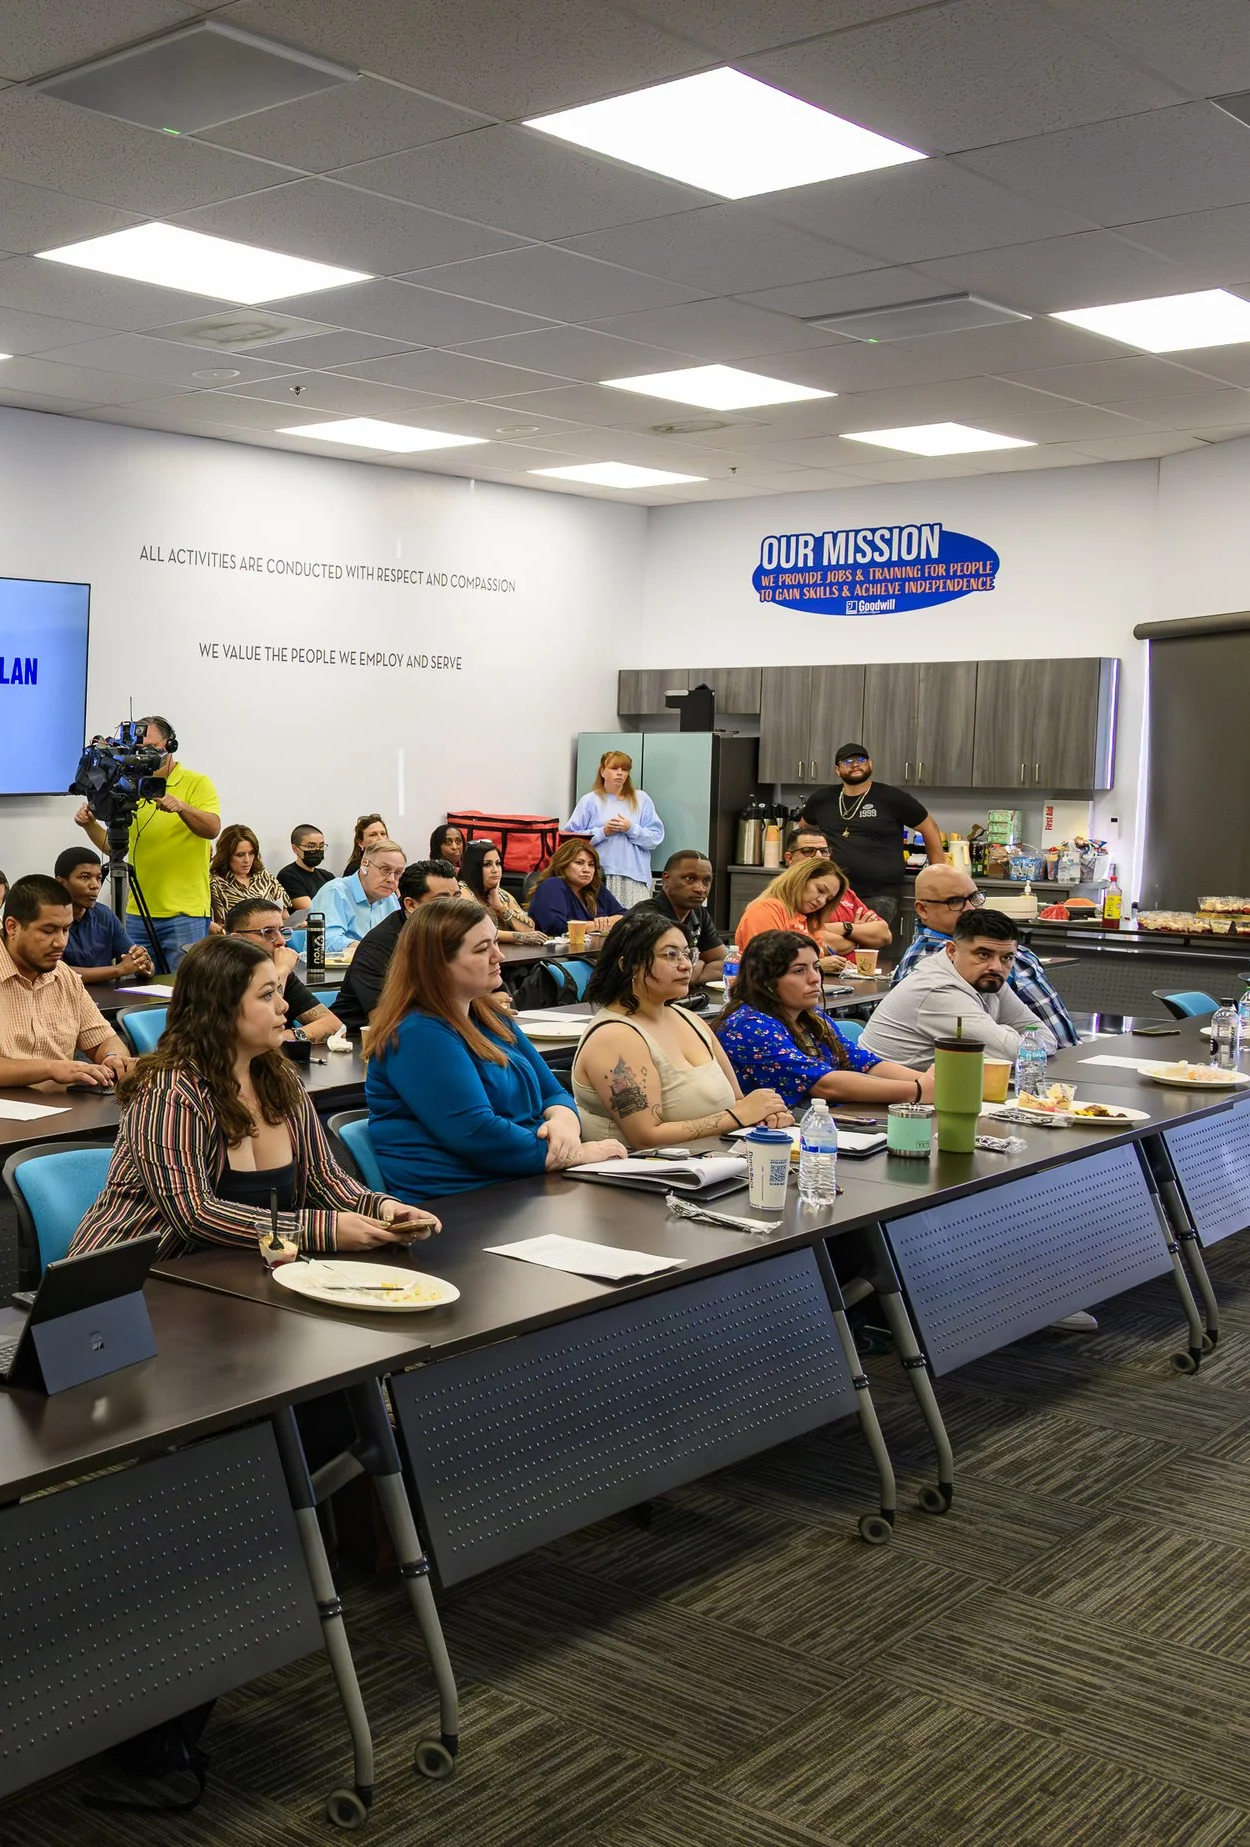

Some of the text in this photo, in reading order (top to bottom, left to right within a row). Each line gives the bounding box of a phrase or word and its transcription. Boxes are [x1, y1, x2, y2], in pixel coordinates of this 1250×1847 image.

[763, 524, 941, 570] OUR MISSION
[140, 545, 516, 593] ALL ACTIVITIES ARE CONDUCTED WITH RESPECT AND COMPASSION
[761, 561, 993, 586] WE PROVIDE JOBS & TRAINING FOR PEOPLE
[759, 576, 995, 601] TO GAIN SKILLS & ACHIEVE INDEPENDENCE
[858, 599, 895, 612] Goodwill
[199, 643, 462, 670] WE VALUE THE PEOPLE WE EMPLOY AND SERVE
[859, 809, 877, 818] 1999
[1045, 806, 1054, 831] First Aid
